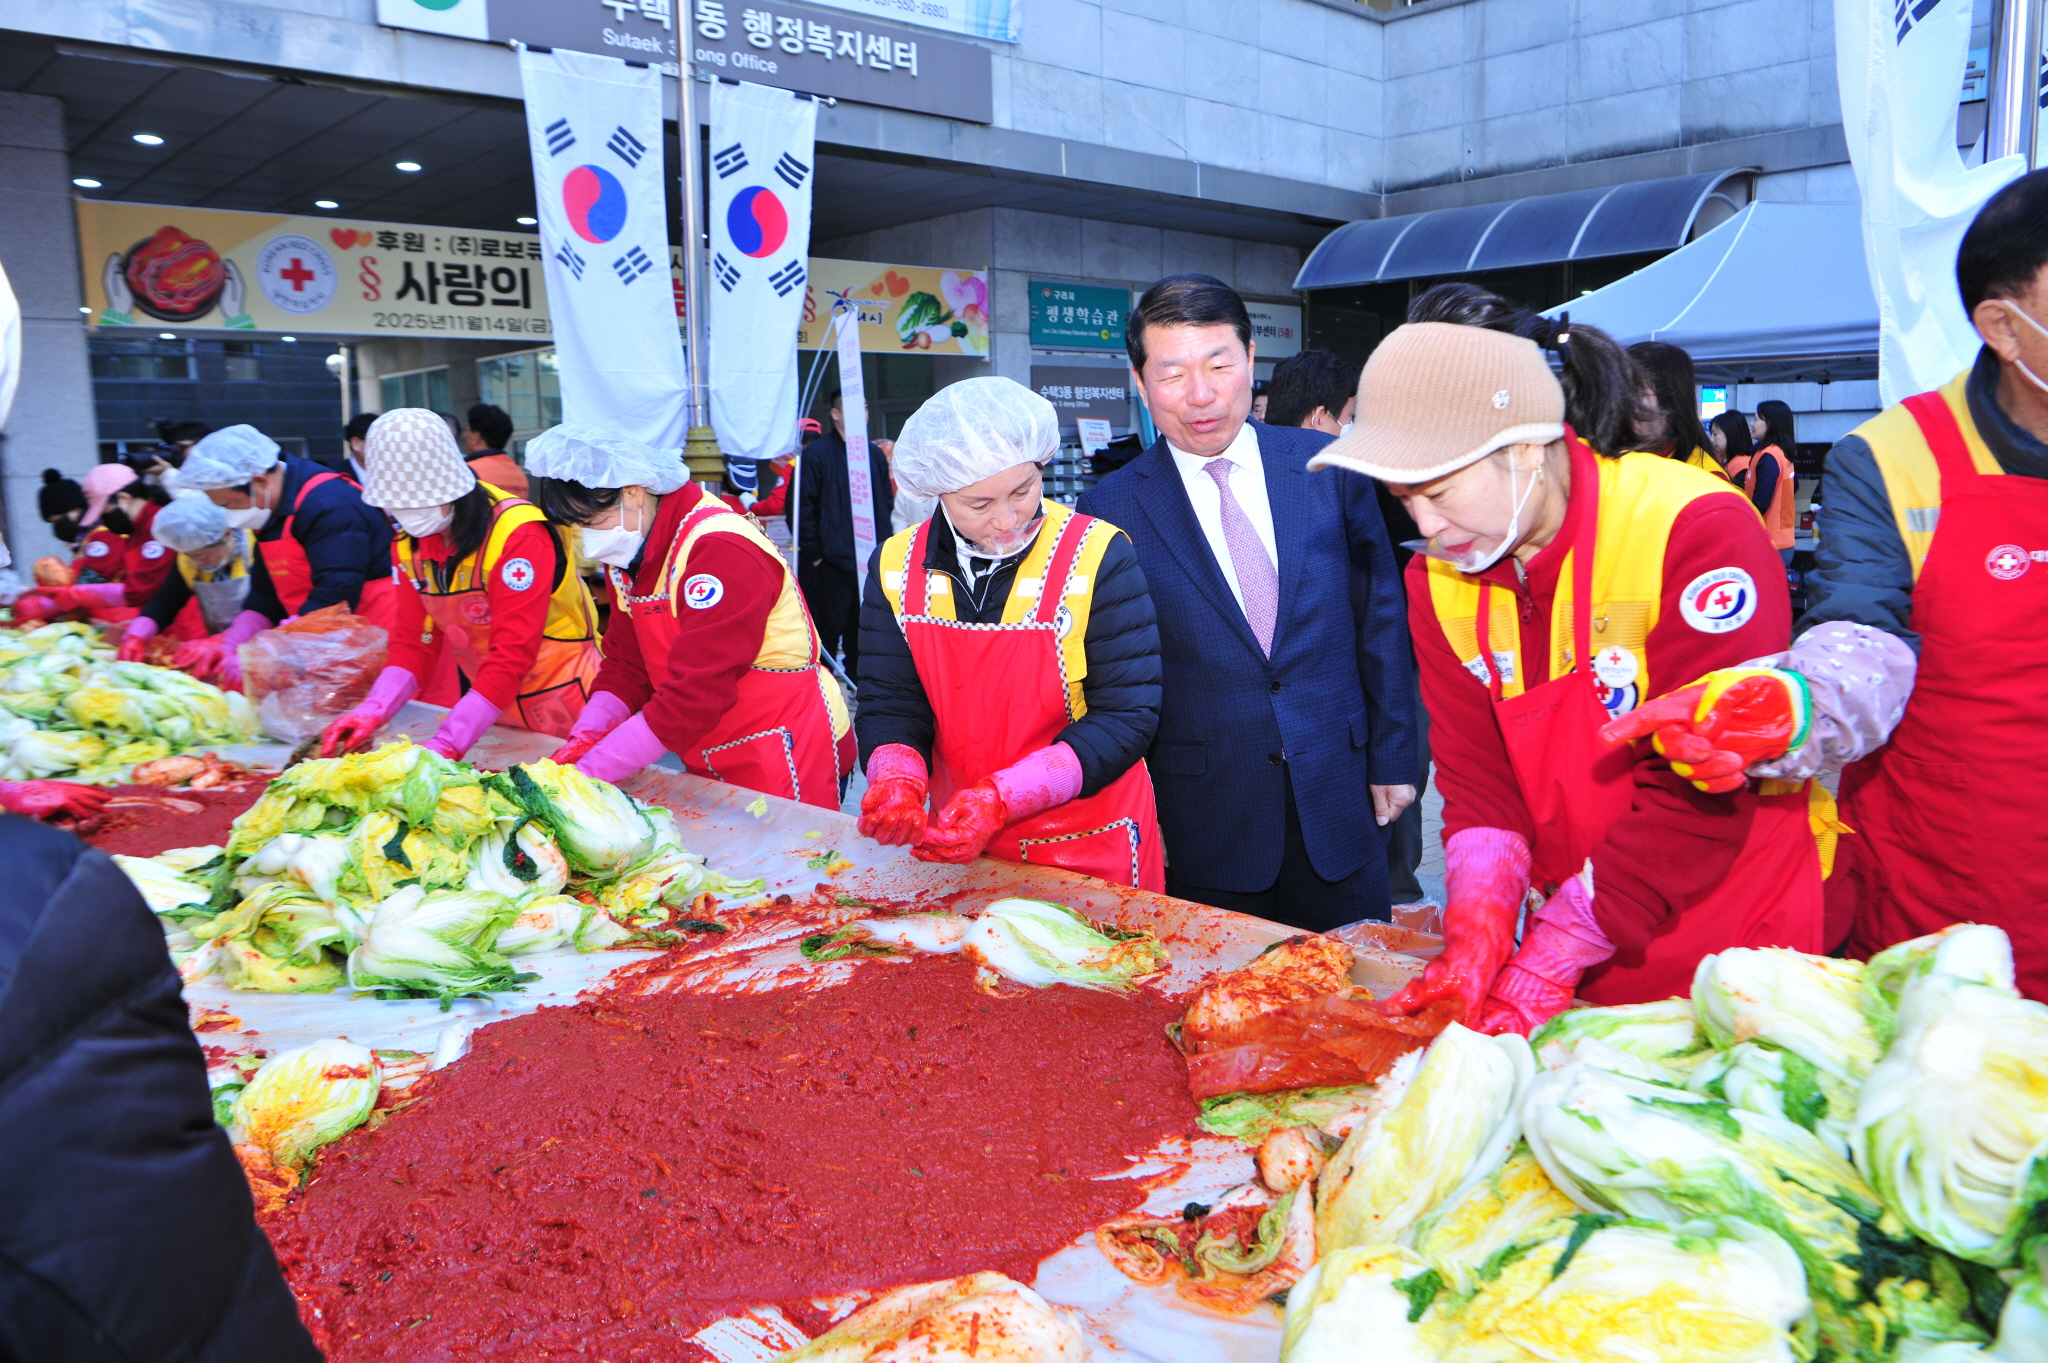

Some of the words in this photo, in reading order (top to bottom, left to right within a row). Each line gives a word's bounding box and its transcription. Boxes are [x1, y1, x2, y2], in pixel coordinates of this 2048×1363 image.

[602, 0, 729, 41] 수택동
[742, 7, 919, 77] 행정복지센터
[602, 27, 664, 55] Sutaek
[695, 48, 727, 67] ong
[731, 51, 779, 74] Office
[376, 230, 426, 253] 후원
[396, 260, 532, 309] 사랑의
[1045, 305, 1119, 327] 평생학습관
[1040, 385, 1073, 400] 수택3동
[1074, 386, 1125, 401] 행정복지센터
